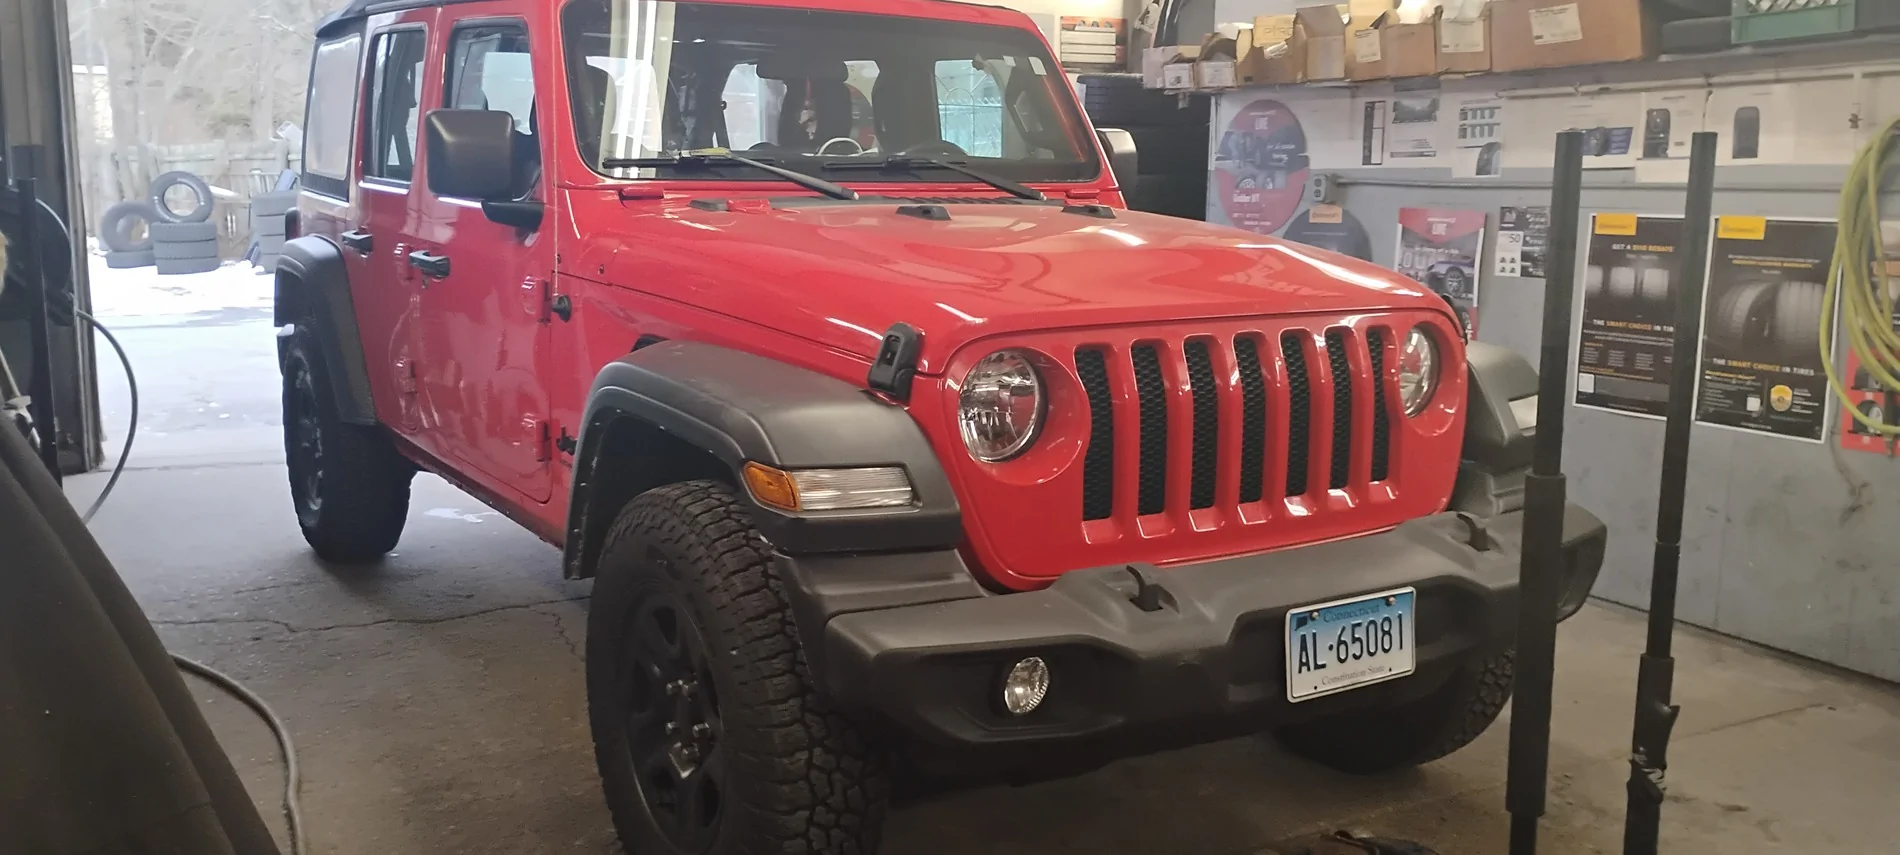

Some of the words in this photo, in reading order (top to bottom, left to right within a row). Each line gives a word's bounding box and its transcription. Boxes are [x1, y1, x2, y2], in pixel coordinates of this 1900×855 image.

[1628, 322, 1652, 330] CHOICE
[1712, 358, 1725, 366] THE
[1727, 360, 1751, 368] SMART
[1753, 362, 1780, 372] CHOICE
[1792, 367, 1815, 376] TIRES
[1323, 604, 1381, 623] Connecticut
[1368, 664, 1385, 676] State
